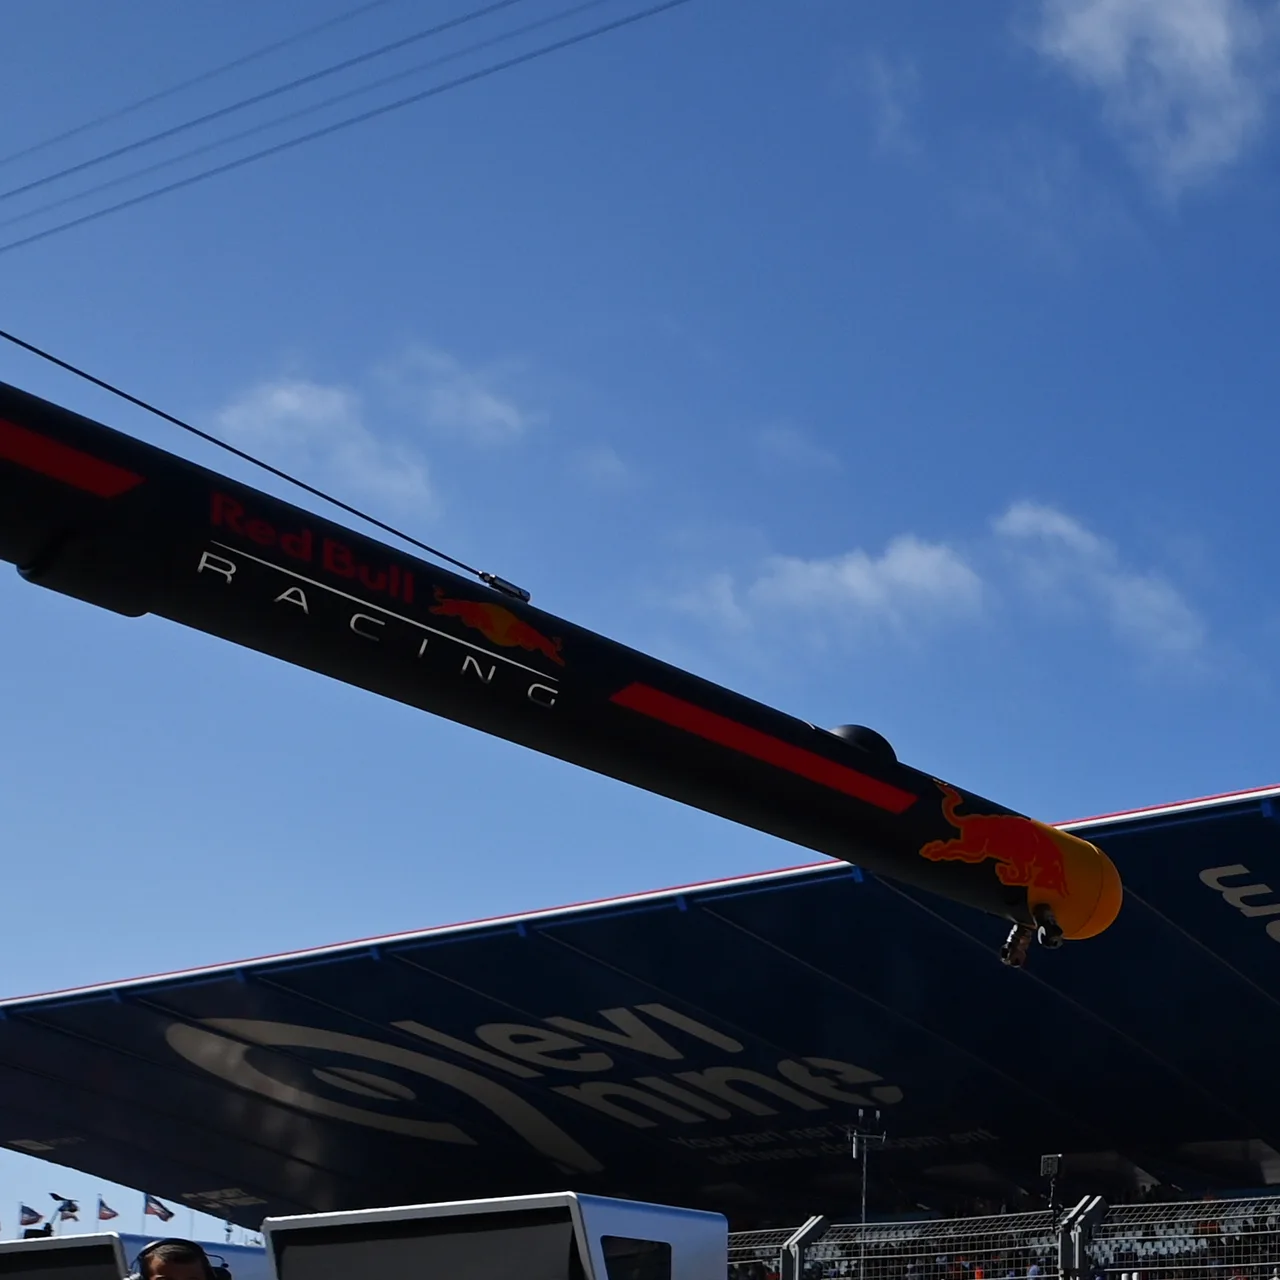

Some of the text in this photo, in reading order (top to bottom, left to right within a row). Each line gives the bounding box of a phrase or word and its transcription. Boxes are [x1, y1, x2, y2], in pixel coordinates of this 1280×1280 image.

[209, 491, 416, 603] Red Bull
[197, 551, 559, 709] RACING
